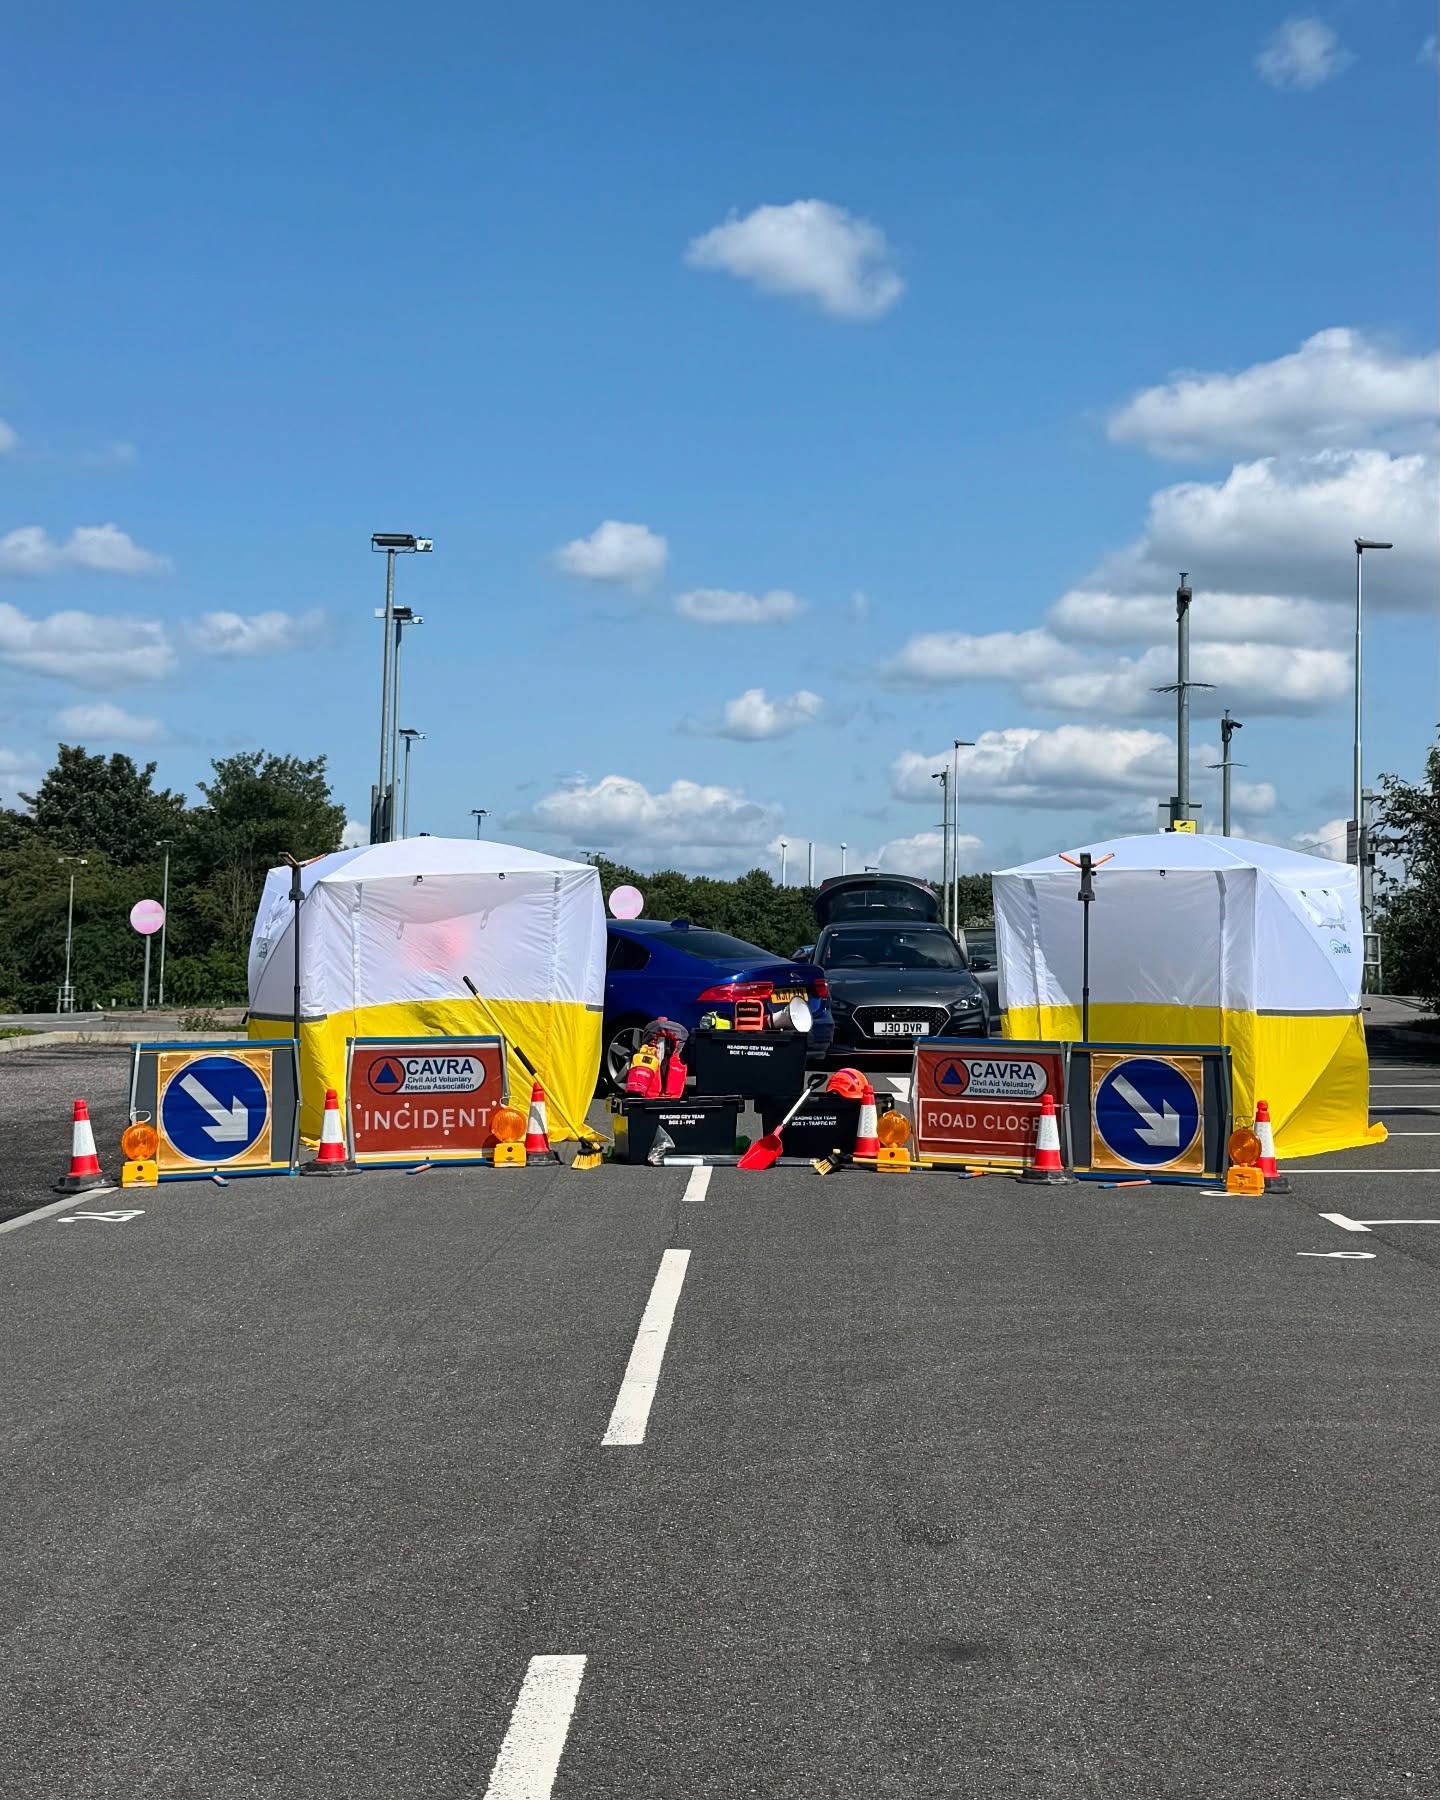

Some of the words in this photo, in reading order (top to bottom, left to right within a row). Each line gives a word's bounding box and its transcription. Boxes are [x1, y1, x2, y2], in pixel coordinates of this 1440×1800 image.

[881, 1022, 900, 1033] J30
[903, 1022, 922, 1033] DVR
[406, 1059, 474, 1075] CAVRA
[970, 1062, 1036, 1080] CAVRA
[407, 1076, 423, 1084] Civil
[438, 1076, 472, 1084] Voluntary
[1002, 1080, 1035, 1089] Voluntary
[969, 1086, 995, 1094] Rescue
[996, 1087, 1037, 1096] Association
[364, 1108, 491, 1131] INCIDENT
[927, 1112, 977, 1129] ROAD
[983, 1115, 1041, 1132] CLOSE
